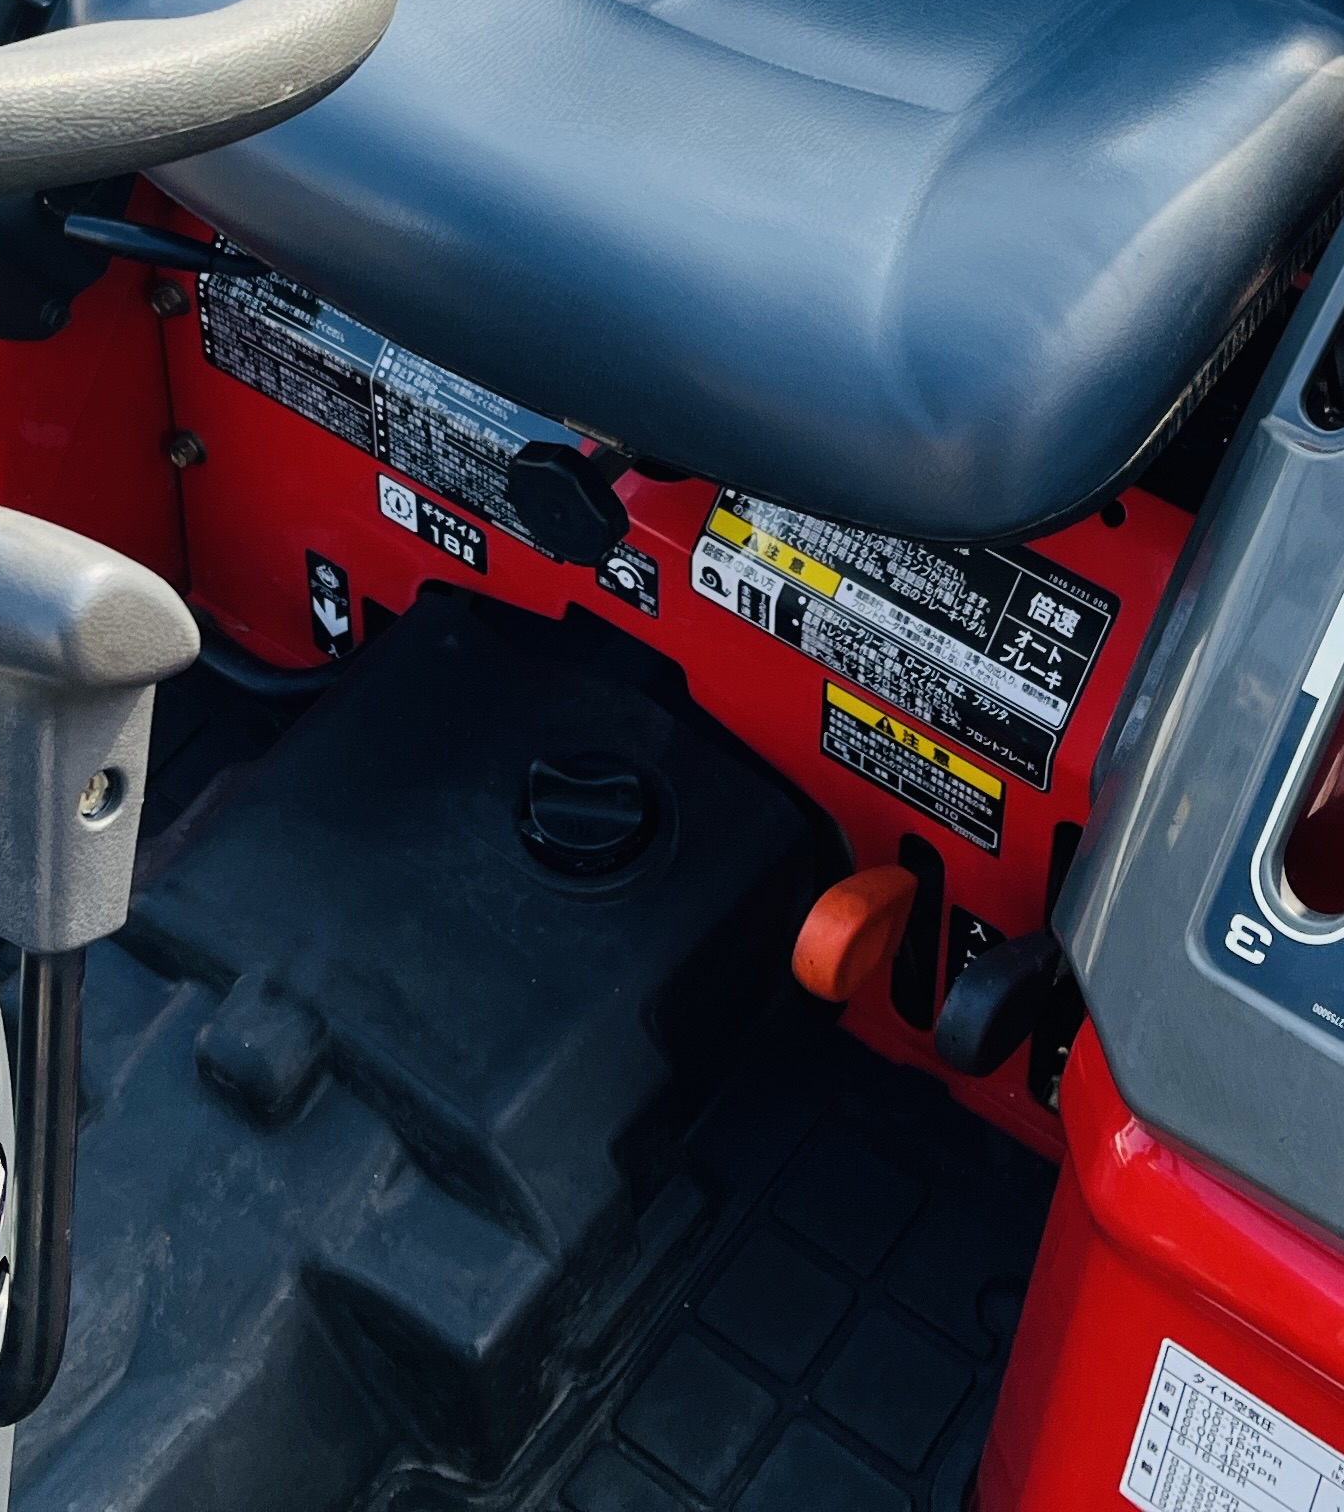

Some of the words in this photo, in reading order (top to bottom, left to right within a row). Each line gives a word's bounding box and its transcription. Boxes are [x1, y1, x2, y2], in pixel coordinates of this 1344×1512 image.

[1028, 590, 1082, 639] 倍速
[999, 647, 1064, 689] ブレーキ
[1014, 629, 1064, 664] オート
[1225, 913, 1274, 968] 3
[1193, 1373, 1276, 1436] タイヤ空気圧
